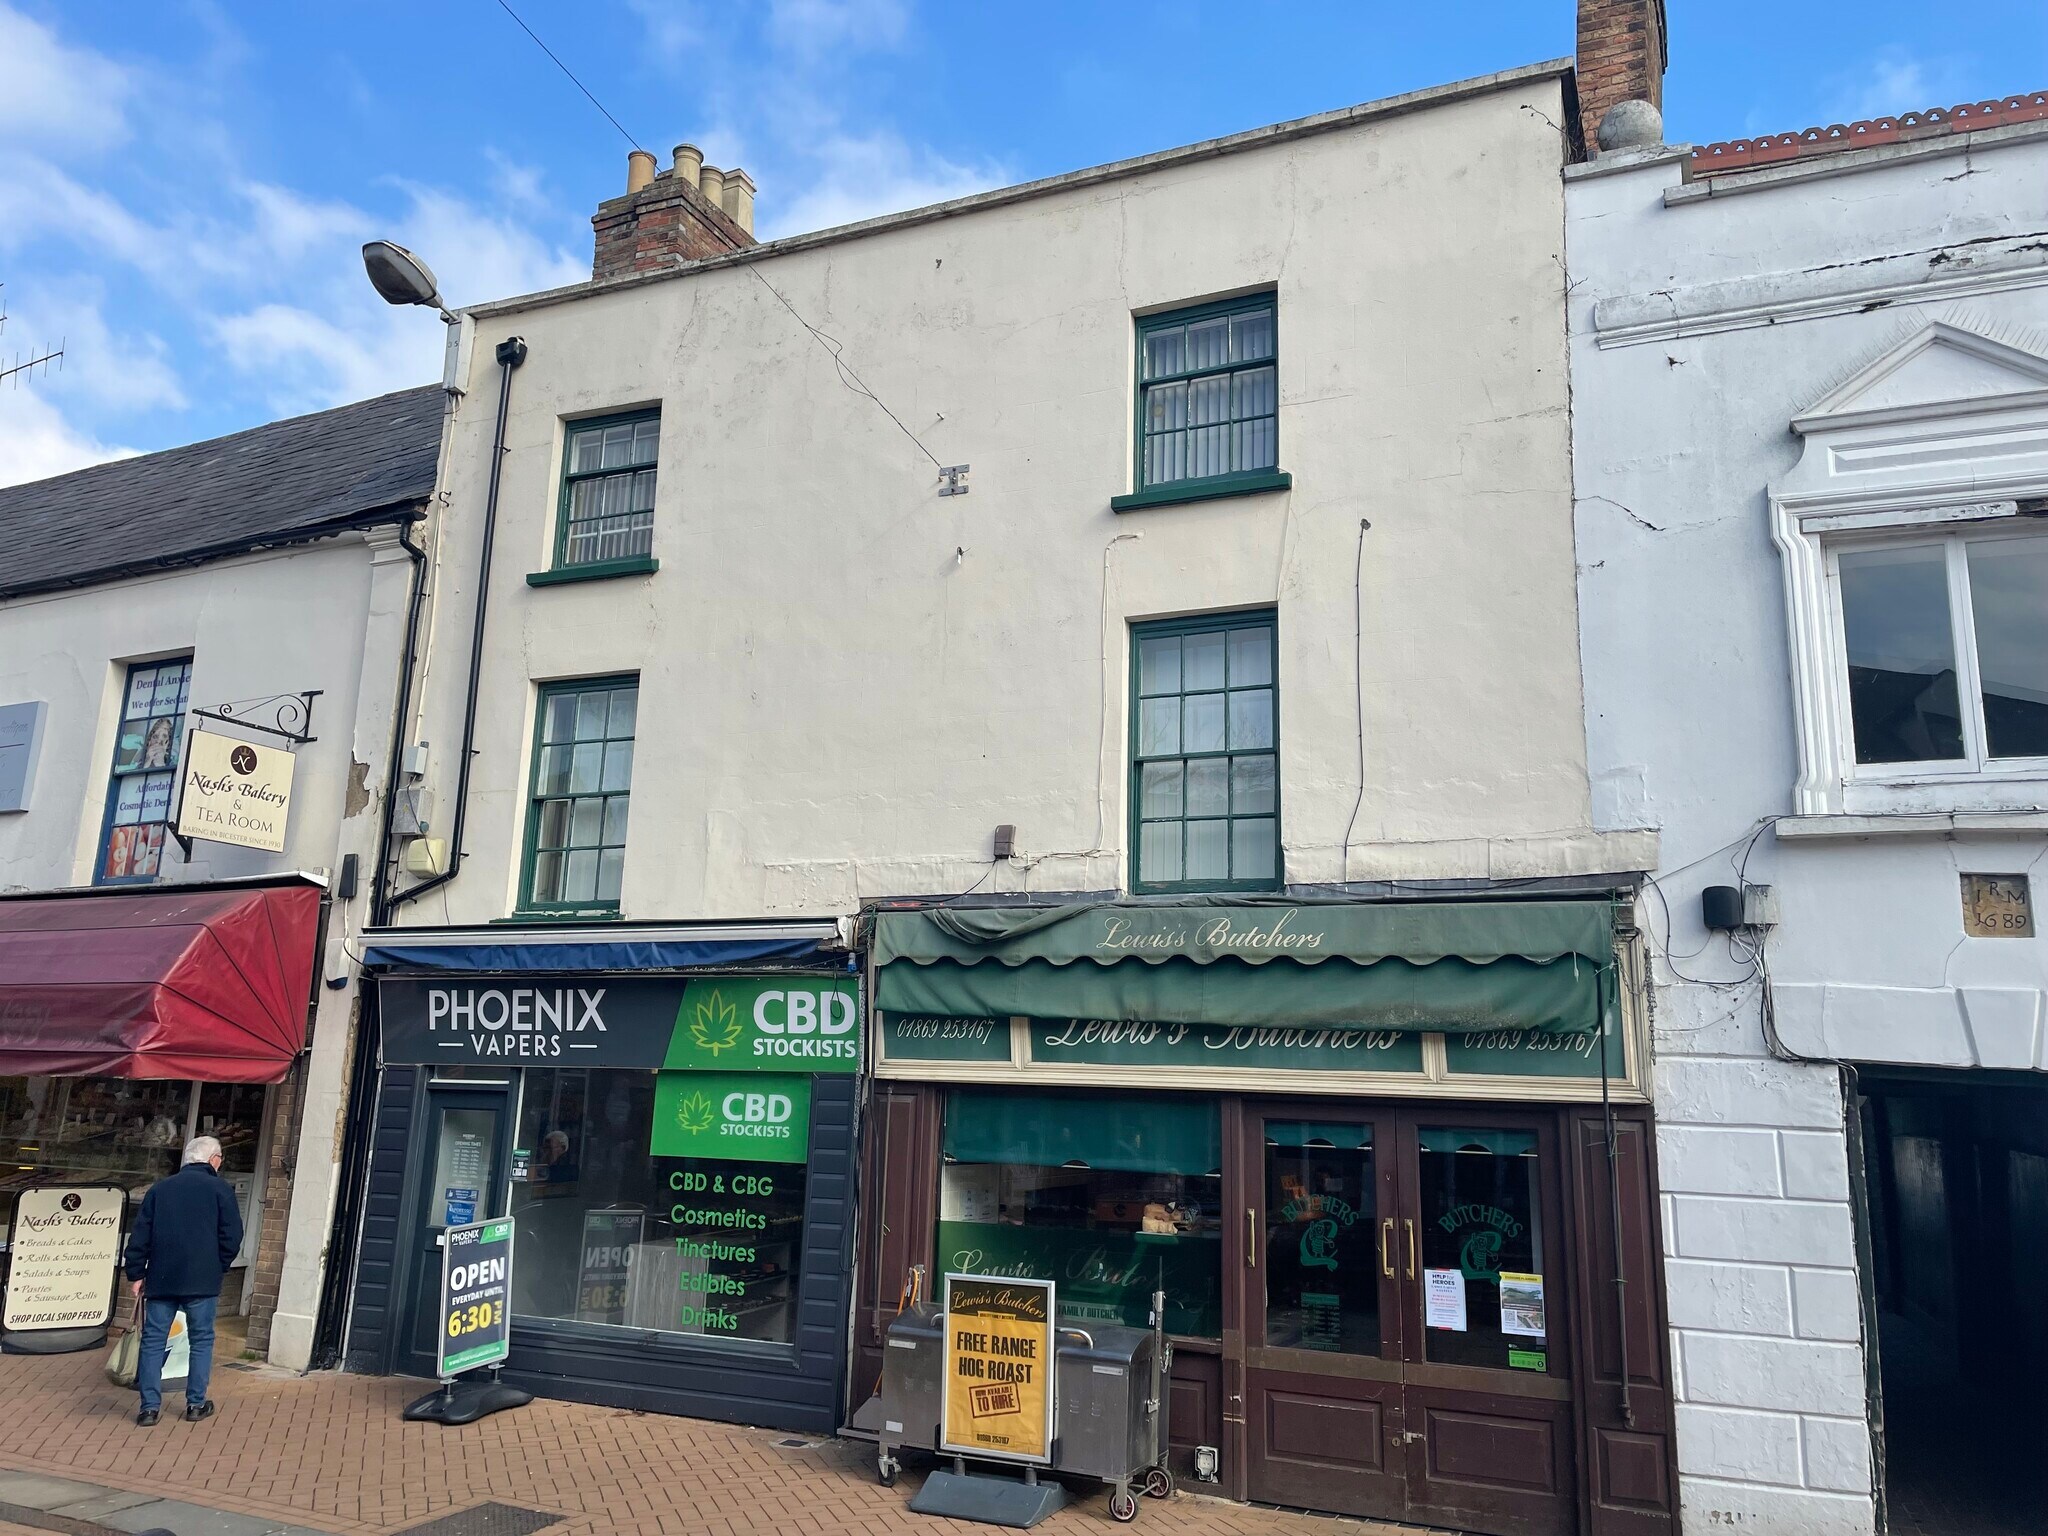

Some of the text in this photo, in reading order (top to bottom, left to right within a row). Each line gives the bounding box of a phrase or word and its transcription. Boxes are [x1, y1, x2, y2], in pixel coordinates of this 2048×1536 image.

[136, 676, 164, 690] Denal
[132, 700, 143, 709] We
[144, 697, 163, 708] ofer
[189, 771, 287, 808] Nash's Bakery
[233, 799, 243, 811] &
[196, 806, 273, 833] TEA ROOM
[182, 825, 209, 835] BAKING
[219, 832, 248, 842] BICESTER
[249, 836, 267, 845] SINCE
[1989, 881, 2000, 896] R
[2007, 890, 2025, 904] M
[1096, 908, 1325, 949] Lewis's Butchers
[1975, 912, 2026, 929] 1689
[428, 988, 607, 1032] PHOENIX
[753, 990, 856, 1035] CBD
[897, 1019, 995, 1045] 01869 253167
[1045, 1019, 1189, 1046] Lewiss
[471, 1034, 561, 1056] VAPERS
[753, 1038, 856, 1058] STOCKISTS
[722, 1092, 792, 1123] CBD
[720, 1124, 790, 1138] STOCKISTS
[669, 1172, 774, 1196] CBD & CBG
[20, 1210, 116, 1232] Nash's Bakery
[671, 1204, 766, 1230] Cosmetics
[1281, 1194, 1360, 1226] BUTCHERS
[1438, 1204, 1523, 1238] BUTCHERS
[26, 1239, 56, 1247] Breads
[67, 1238, 93, 1246] Cakes
[452, 1224, 508, 1243] PHOENIX CBD
[24, 1254, 50, 1263] Rolls
[61, 1252, 111, 1262] Sandwiches
[675, 1238, 756, 1263] Tinctures
[22, 1269, 53, 1278] Salads
[64, 1268, 90, 1277] Soups
[450, 1257, 505, 1291] OPEN
[679, 1272, 745, 1297] Edibles
[21, 1285, 52, 1293] Pasties
[34, 1293, 71, 1303] Sausage
[71, 1291, 97, 1301] Rolls
[452, 1285, 504, 1306] EVERYDAY UNTIL
[493, 1300, 503, 1325] PM
[951, 1288, 1046, 1319] Lewis's Butchers
[1058, 1304, 1085, 1317] FAMILY
[10, 1310, 102, 1324] SHOP LOCAL SHOP FRESH
[448, 1302, 492, 1337] 6:30
[682, 1306, 738, 1330] Drinks
[957, 1331, 1036, 1359] FREE RANGE
[959, 1357, 1033, 1384] HOG ROAST
[976, 1393, 1016, 1412] TO HIRE
